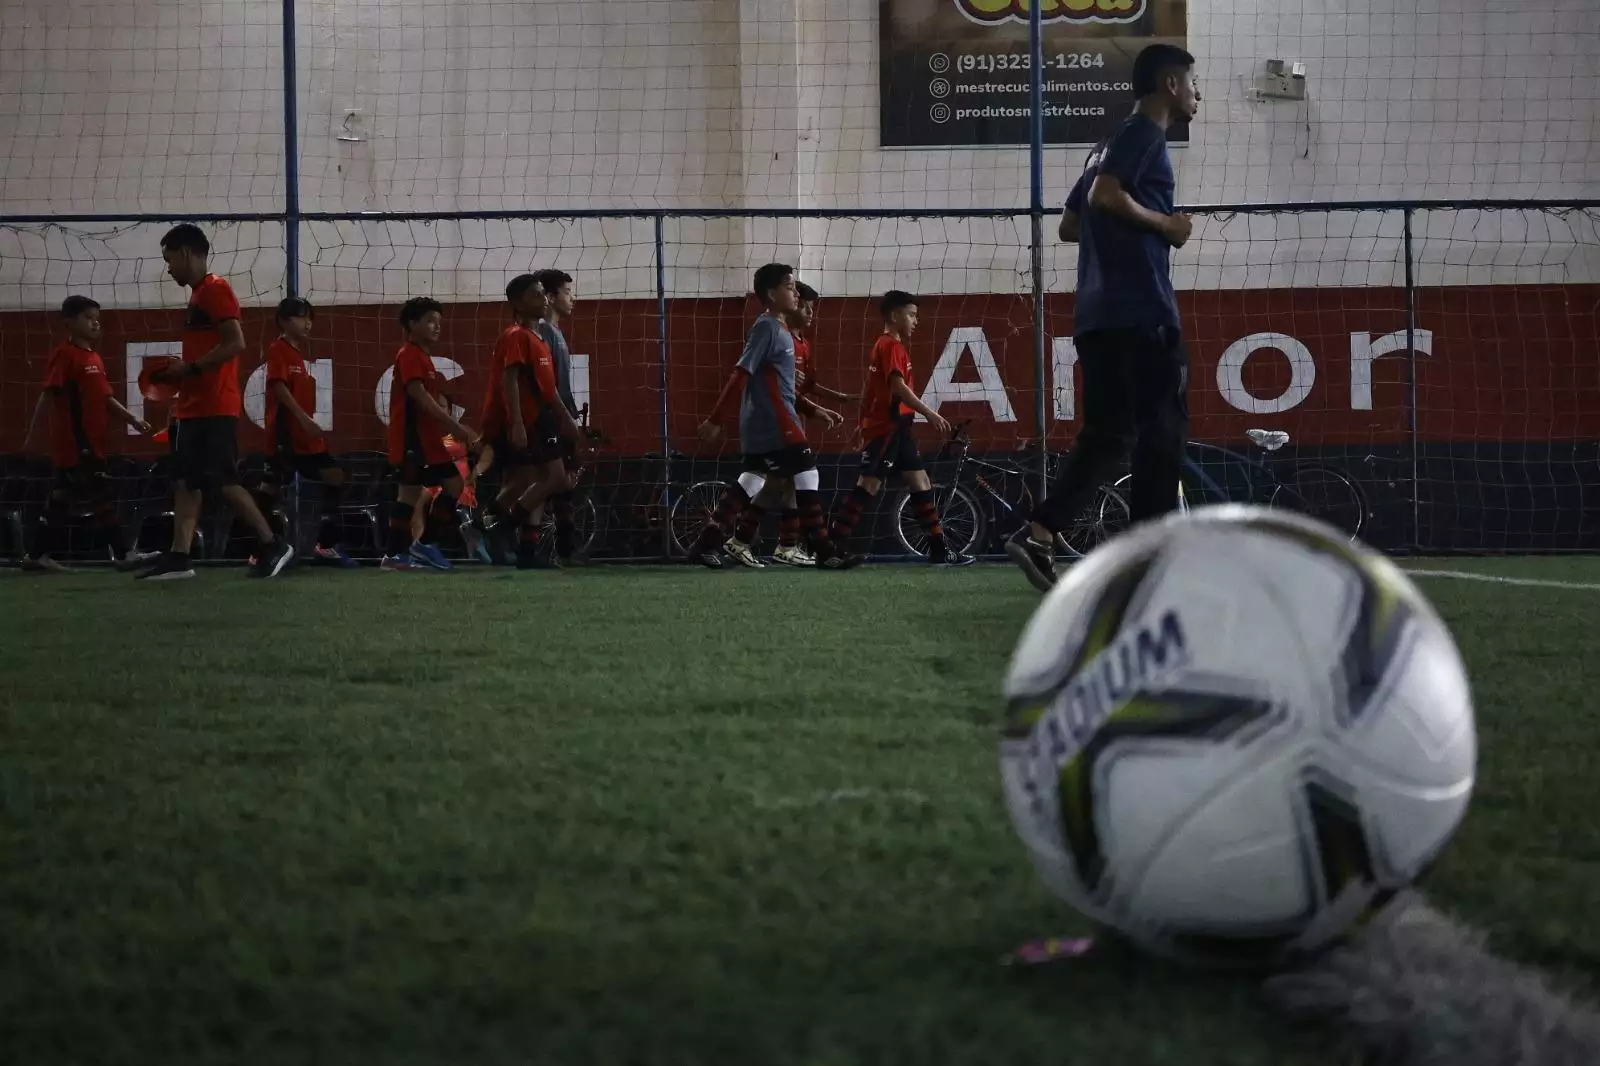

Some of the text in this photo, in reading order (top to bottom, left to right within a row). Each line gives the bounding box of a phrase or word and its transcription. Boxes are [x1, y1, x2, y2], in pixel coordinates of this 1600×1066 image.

[955, 80, 1134, 94] mestrecucalimentos.co
[955, 105, 1106, 121] produtosmstrecuca
[913, 325, 1433, 424] Aor
